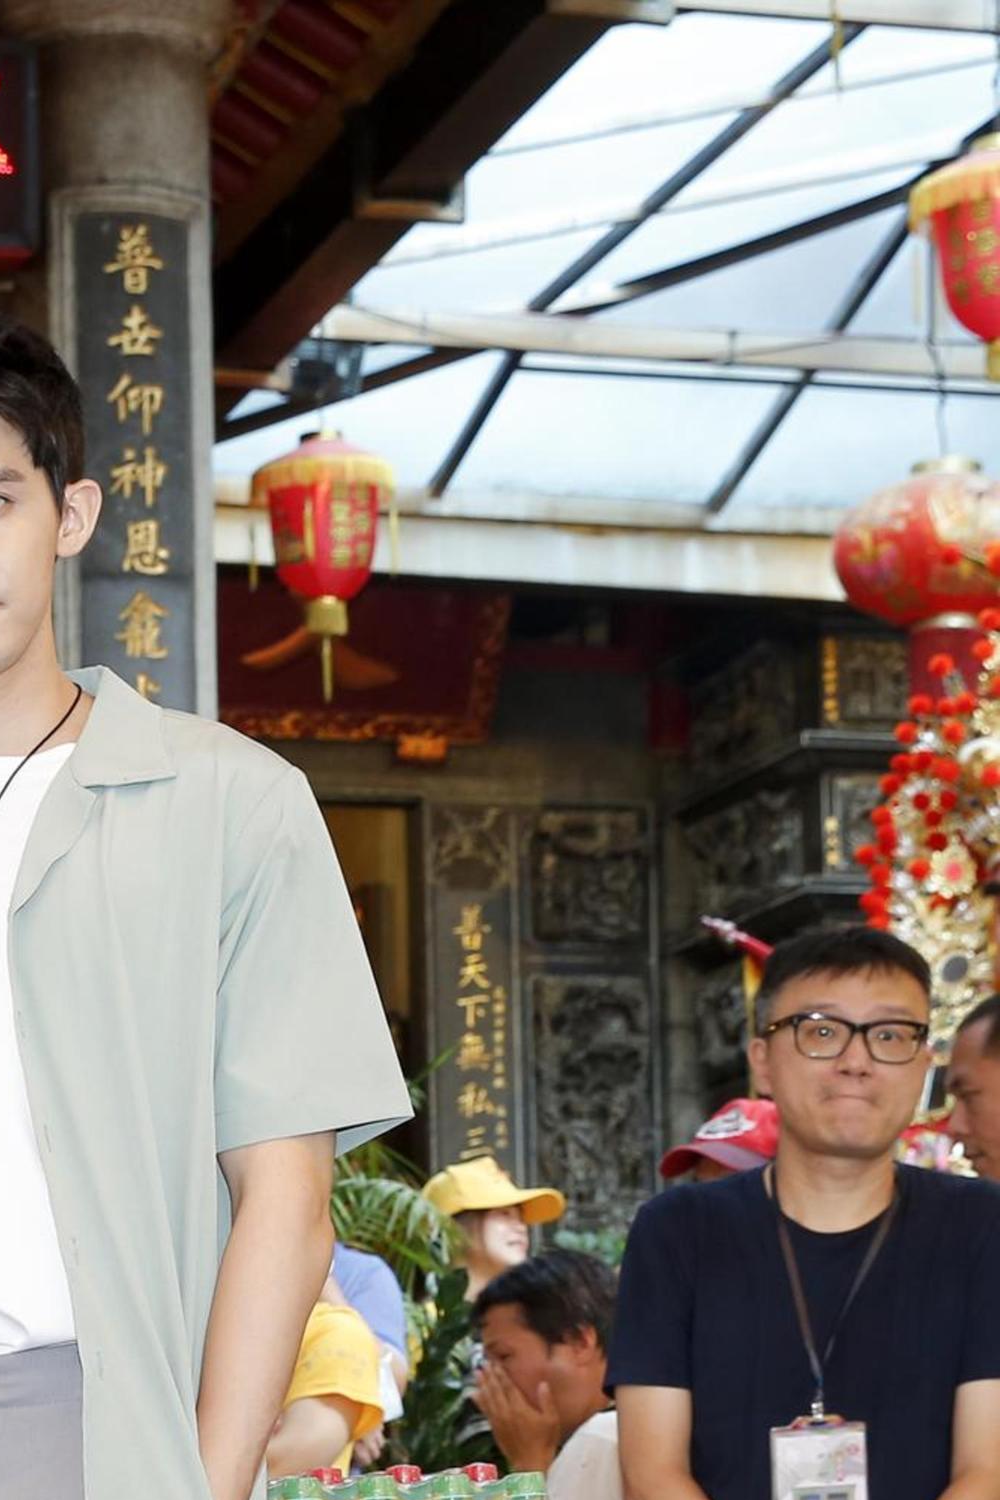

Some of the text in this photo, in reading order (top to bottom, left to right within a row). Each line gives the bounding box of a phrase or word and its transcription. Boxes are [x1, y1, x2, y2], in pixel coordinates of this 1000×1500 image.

[104, 223, 168, 700] 普世仰神恩龕
